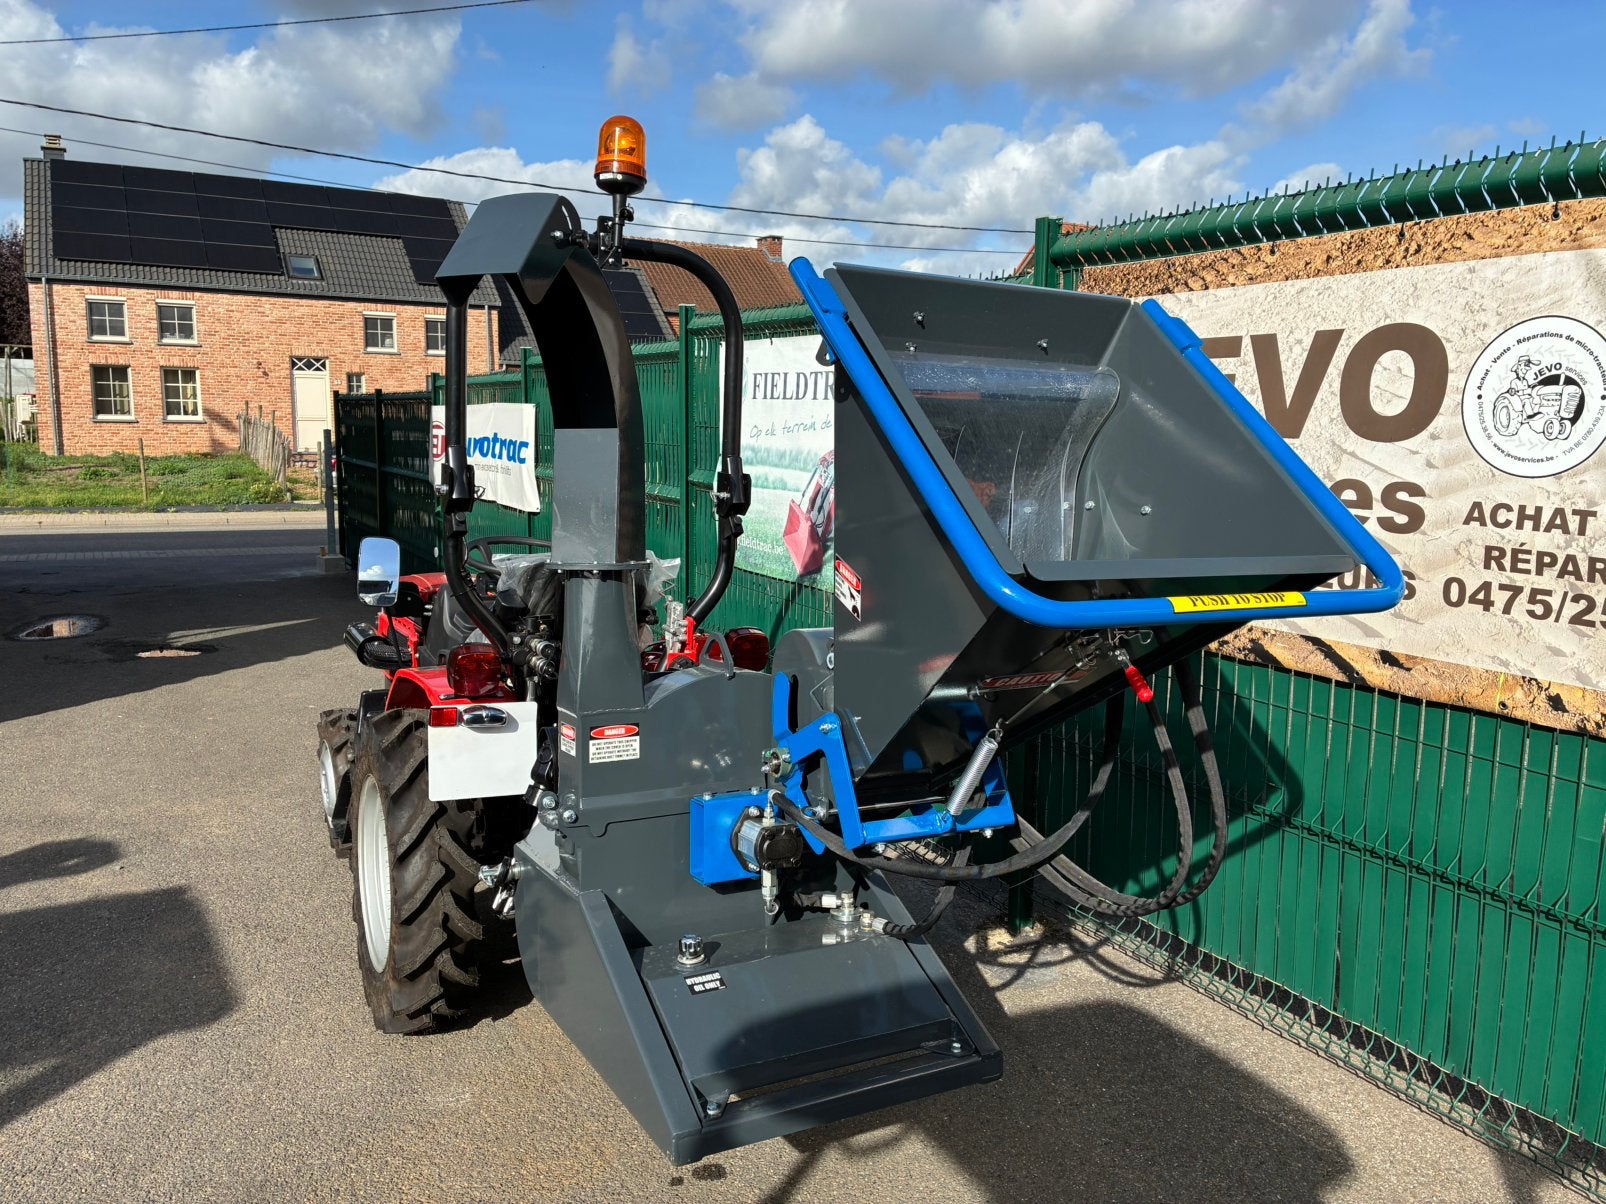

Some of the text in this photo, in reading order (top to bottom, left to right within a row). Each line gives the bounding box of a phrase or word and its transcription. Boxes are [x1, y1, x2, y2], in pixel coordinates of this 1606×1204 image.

[1477, 368, 1491, 391] Achat
[1491, 346, 1512, 364] Vente
[1516, 331, 1564, 346] Réparations
[1565, 334, 1575, 342] de
[1201, 322, 1449, 443] VO
[1533, 362, 1587, 386] JEVO services
[750, 424, 763, 441] Op
[782, 415, 817, 435] terrein
[820, 413, 833, 430] de
[1493, 443, 1555, 463] www.jevoservices.be
[1562, 447, 1576, 456] TVA
[1574, 440, 1584, 449] BE
[1462, 500, 1598, 537] ACHAT
[1483, 542, 1606, 586] RÉPAR
[1188, 592, 1286, 608] PUSH TO STOP
[1442, 576, 1606, 630] 0475/2
[994, 672, 1065, 687] CAUTIO
[604, 728, 626, 736] DANGER
[685, 972, 721, 985] HYDRAULIC
[693, 984, 705, 992] OIL
[704, 981, 721, 990] ONLY
